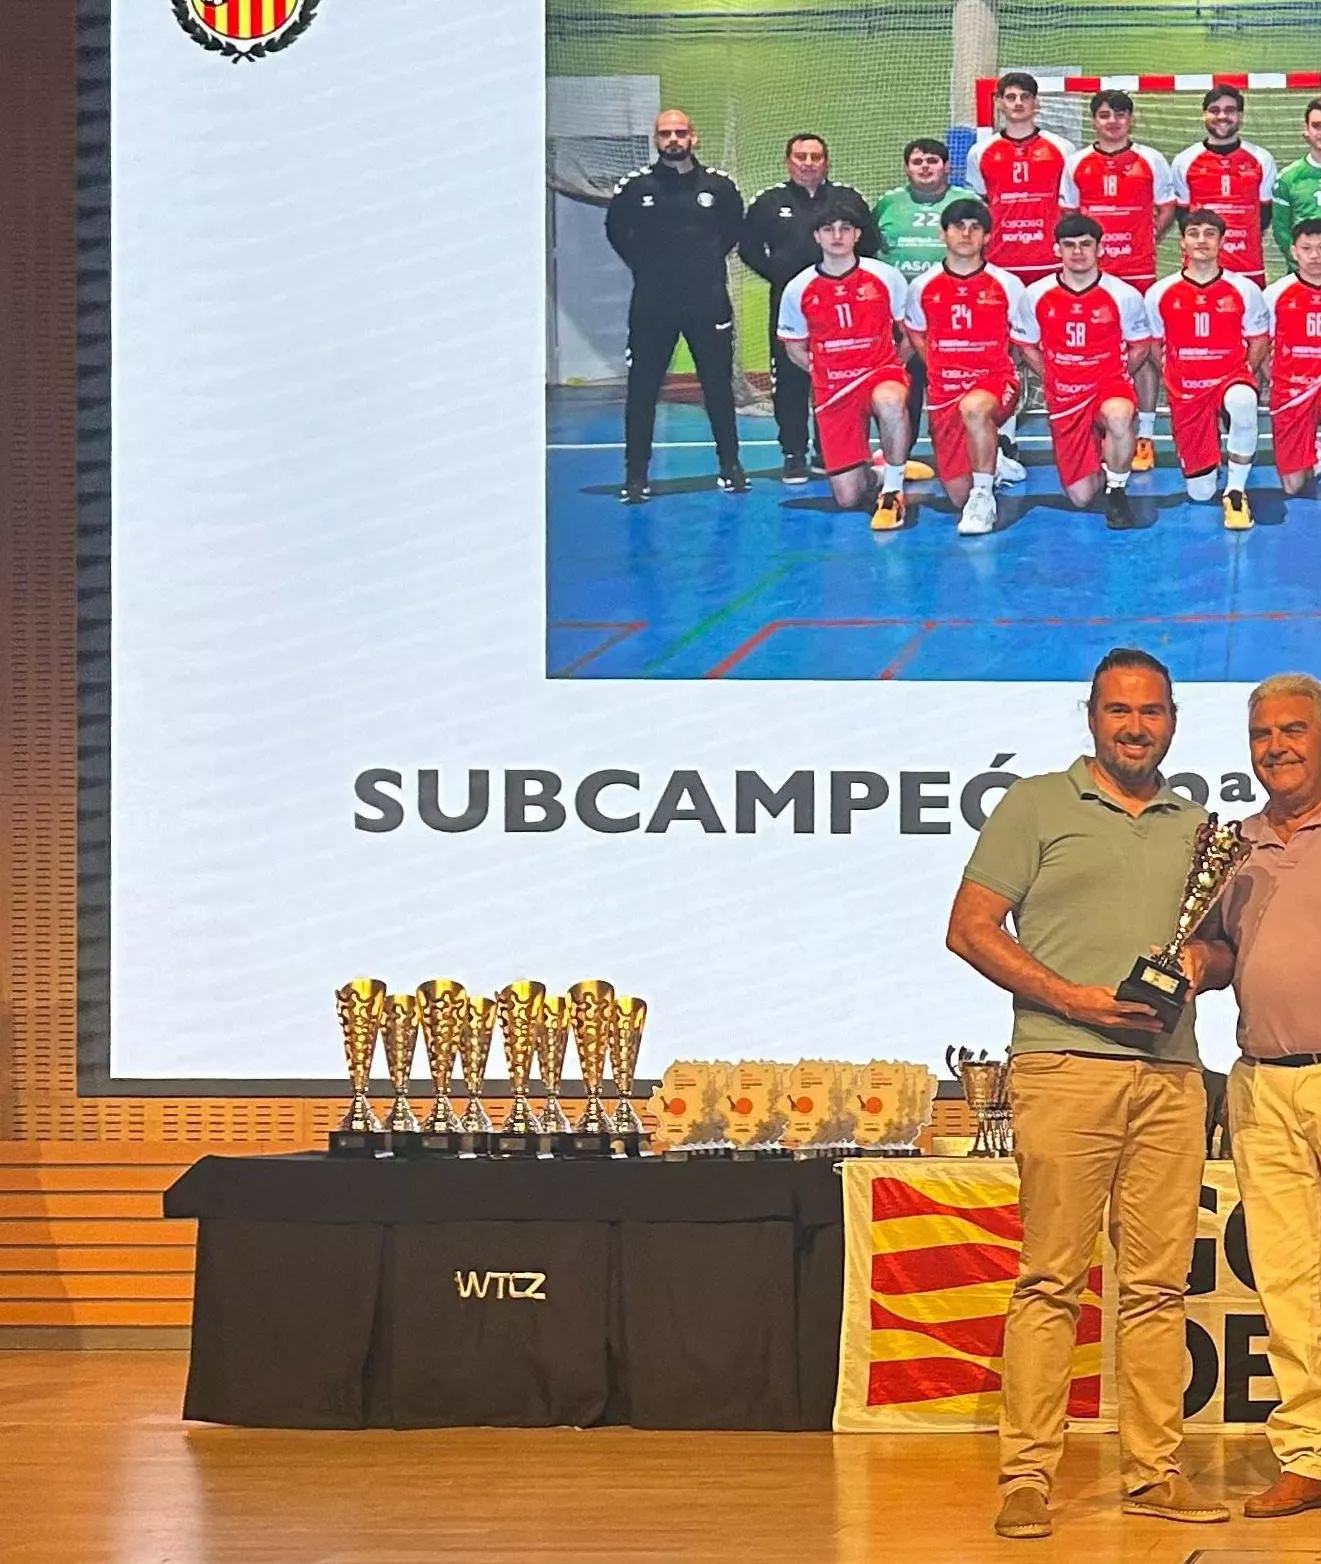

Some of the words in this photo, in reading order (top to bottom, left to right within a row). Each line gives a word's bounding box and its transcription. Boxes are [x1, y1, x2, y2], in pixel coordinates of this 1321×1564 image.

[1012, 161, 1029, 183] 21
[1103, 175, 1118, 197] 18
[1221, 175, 1231, 197] 8
[912, 212, 939, 227] 22
[834, 303, 853, 328] 11
[951, 304, 972, 329] 24
[1193, 312, 1210, 337] 10
[1066, 322, 1086, 347] 58
[353, 752, 1023, 835] SUBCAMPEÓ
[455, 1271, 546, 1299] WTCZ
